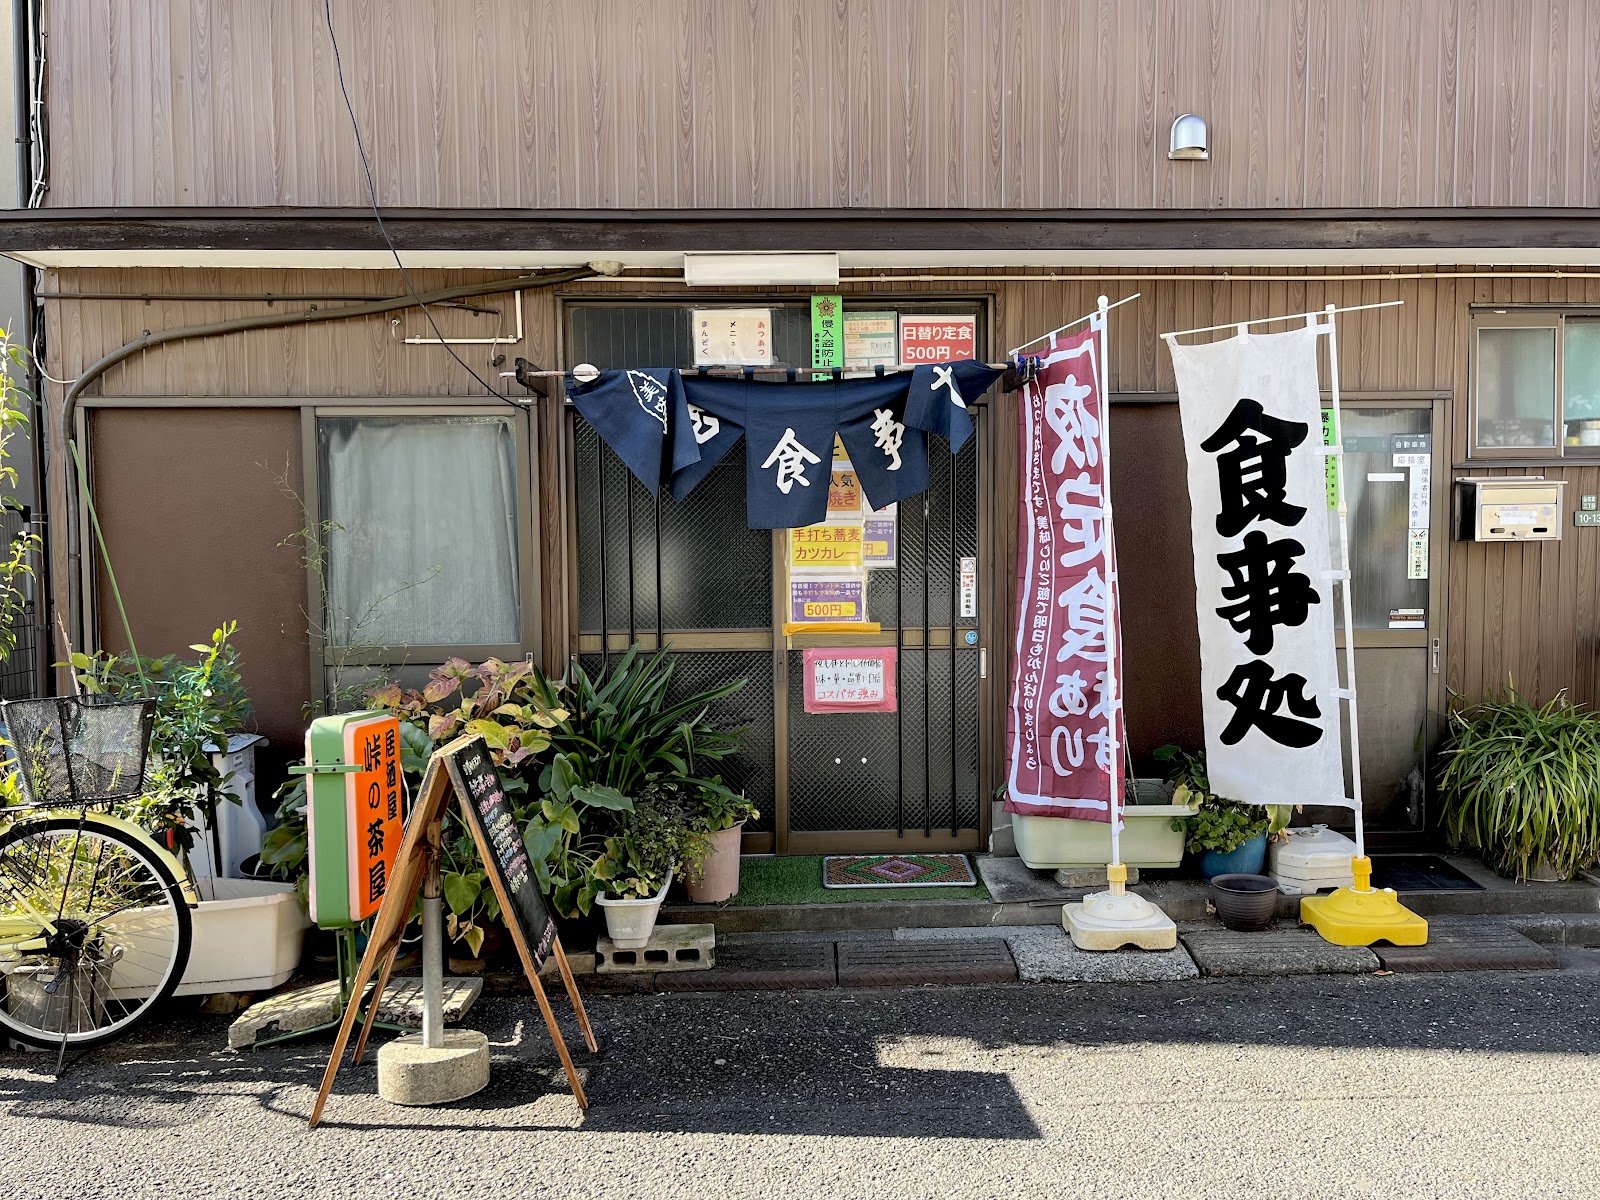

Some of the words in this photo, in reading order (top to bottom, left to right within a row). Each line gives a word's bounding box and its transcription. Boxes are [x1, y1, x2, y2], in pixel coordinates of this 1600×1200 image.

[757, 321, 765, 356] あつあつ
[903, 326, 972, 341] 日替り定食
[821, 319, 834, 367] 侵入盗防止
[1397, 455, 1426, 464] 応接室
[829, 474, 854, 488] 人気
[1421, 468, 1429, 507] 関係者以外
[829, 490, 856, 506] 焼き
[793, 528, 860, 542] 手打ち蕎麦
[795, 546, 859, 560] カツカレー
[1200, 398, 1323, 748] 食事処
[817, 687, 878, 700] コスパが強み
[385, 728, 397, 821] 居酒屋
[364, 734, 387, 904] 峠の茶屋
